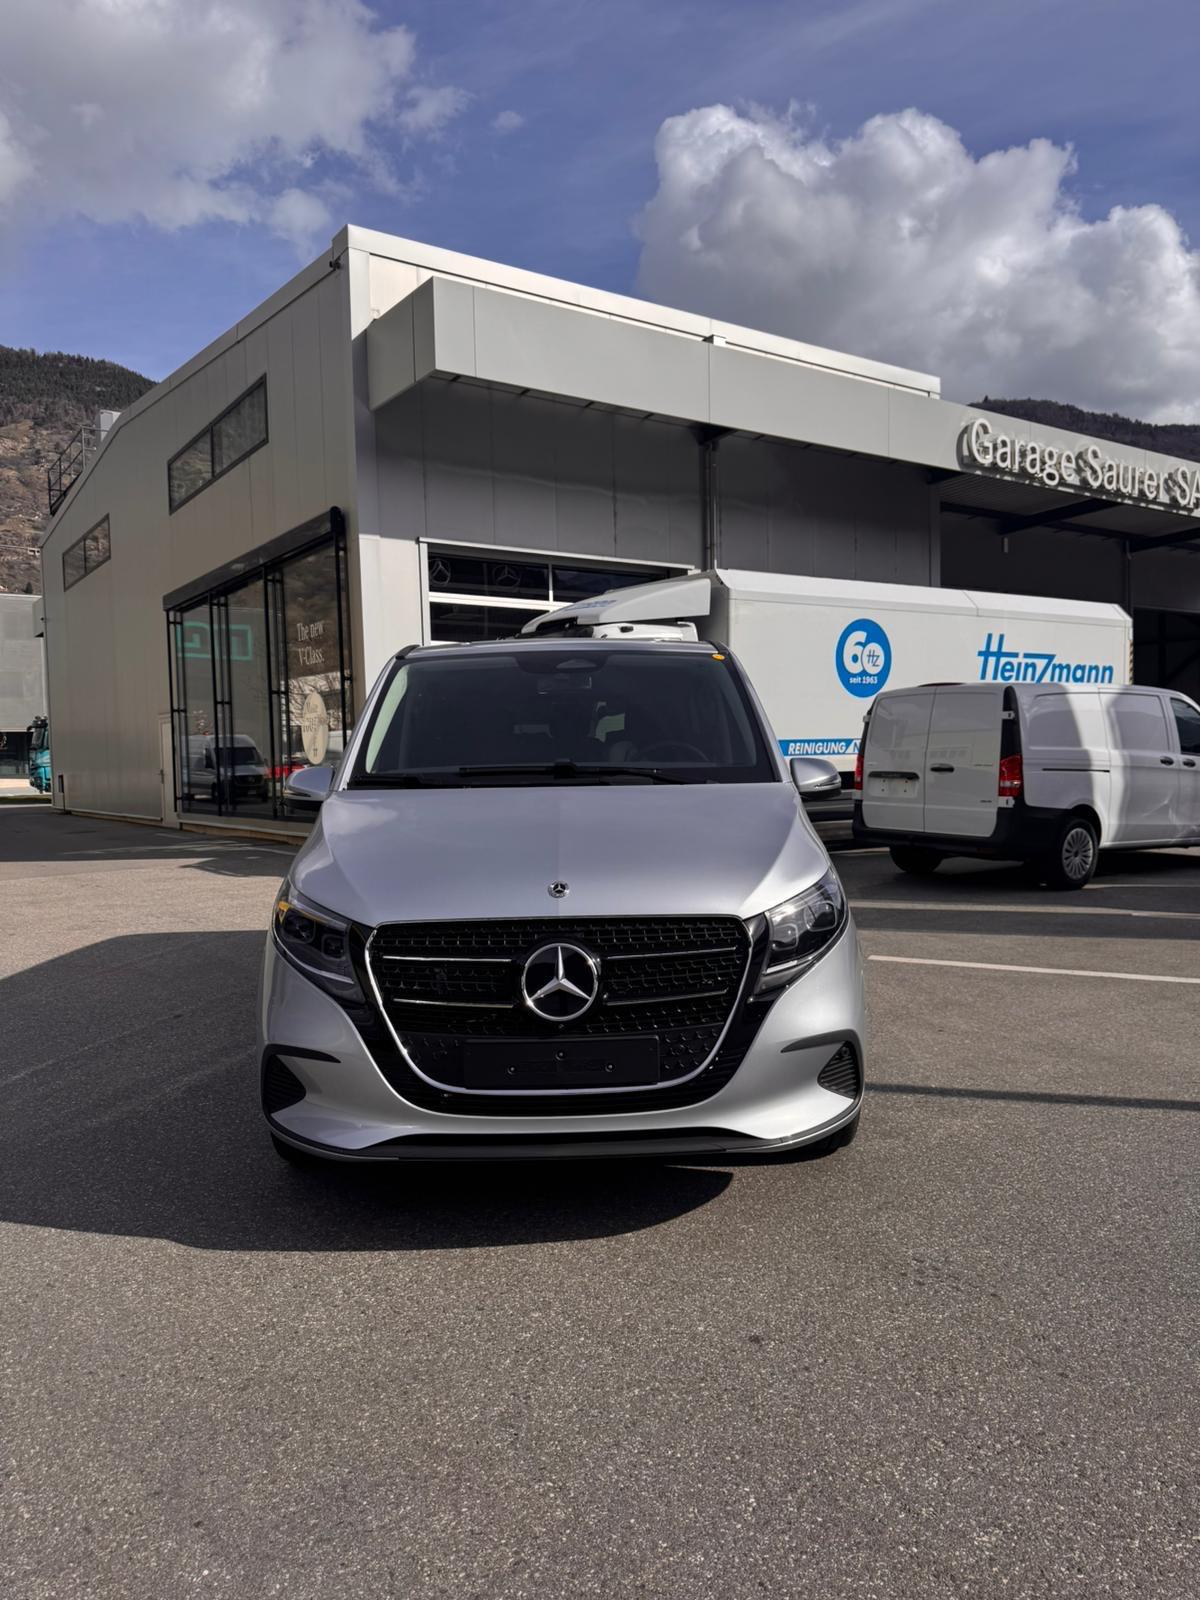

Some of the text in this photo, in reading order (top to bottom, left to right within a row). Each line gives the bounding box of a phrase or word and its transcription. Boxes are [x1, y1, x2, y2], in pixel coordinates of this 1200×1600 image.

[970, 418, 1076, 485] Garage
[1086, 445, 1170, 500] Saurer
[296, 621, 324, 641] The new
[849, 675, 878, 684] seit 1963
[788, 741, 846, 754] REINIGUNG
